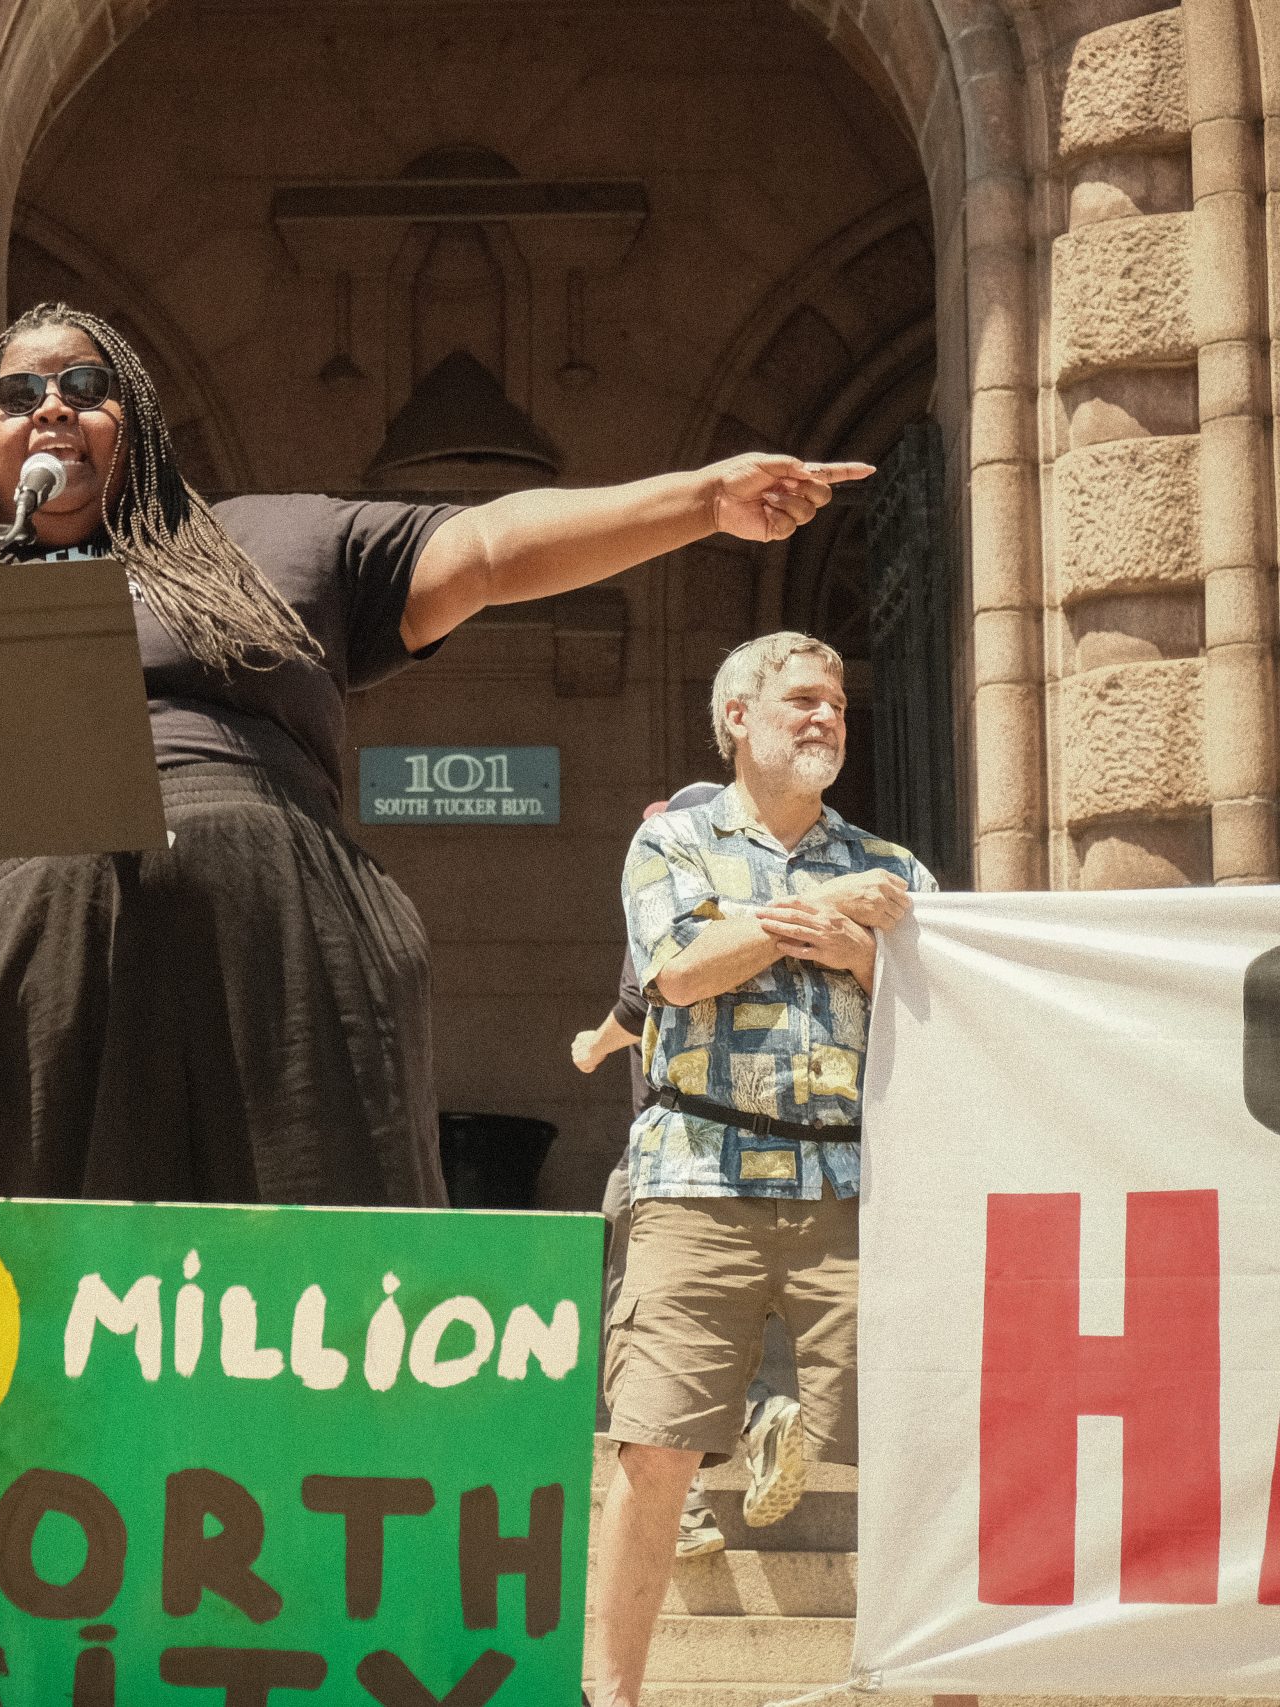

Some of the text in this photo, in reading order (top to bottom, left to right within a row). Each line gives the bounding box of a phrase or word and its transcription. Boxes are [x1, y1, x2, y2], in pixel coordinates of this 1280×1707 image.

[404, 754, 514, 793] 101
[374, 798, 545, 816] SOUTH TUCKER BLVD.
[978, 1190, 1280, 1606] H
